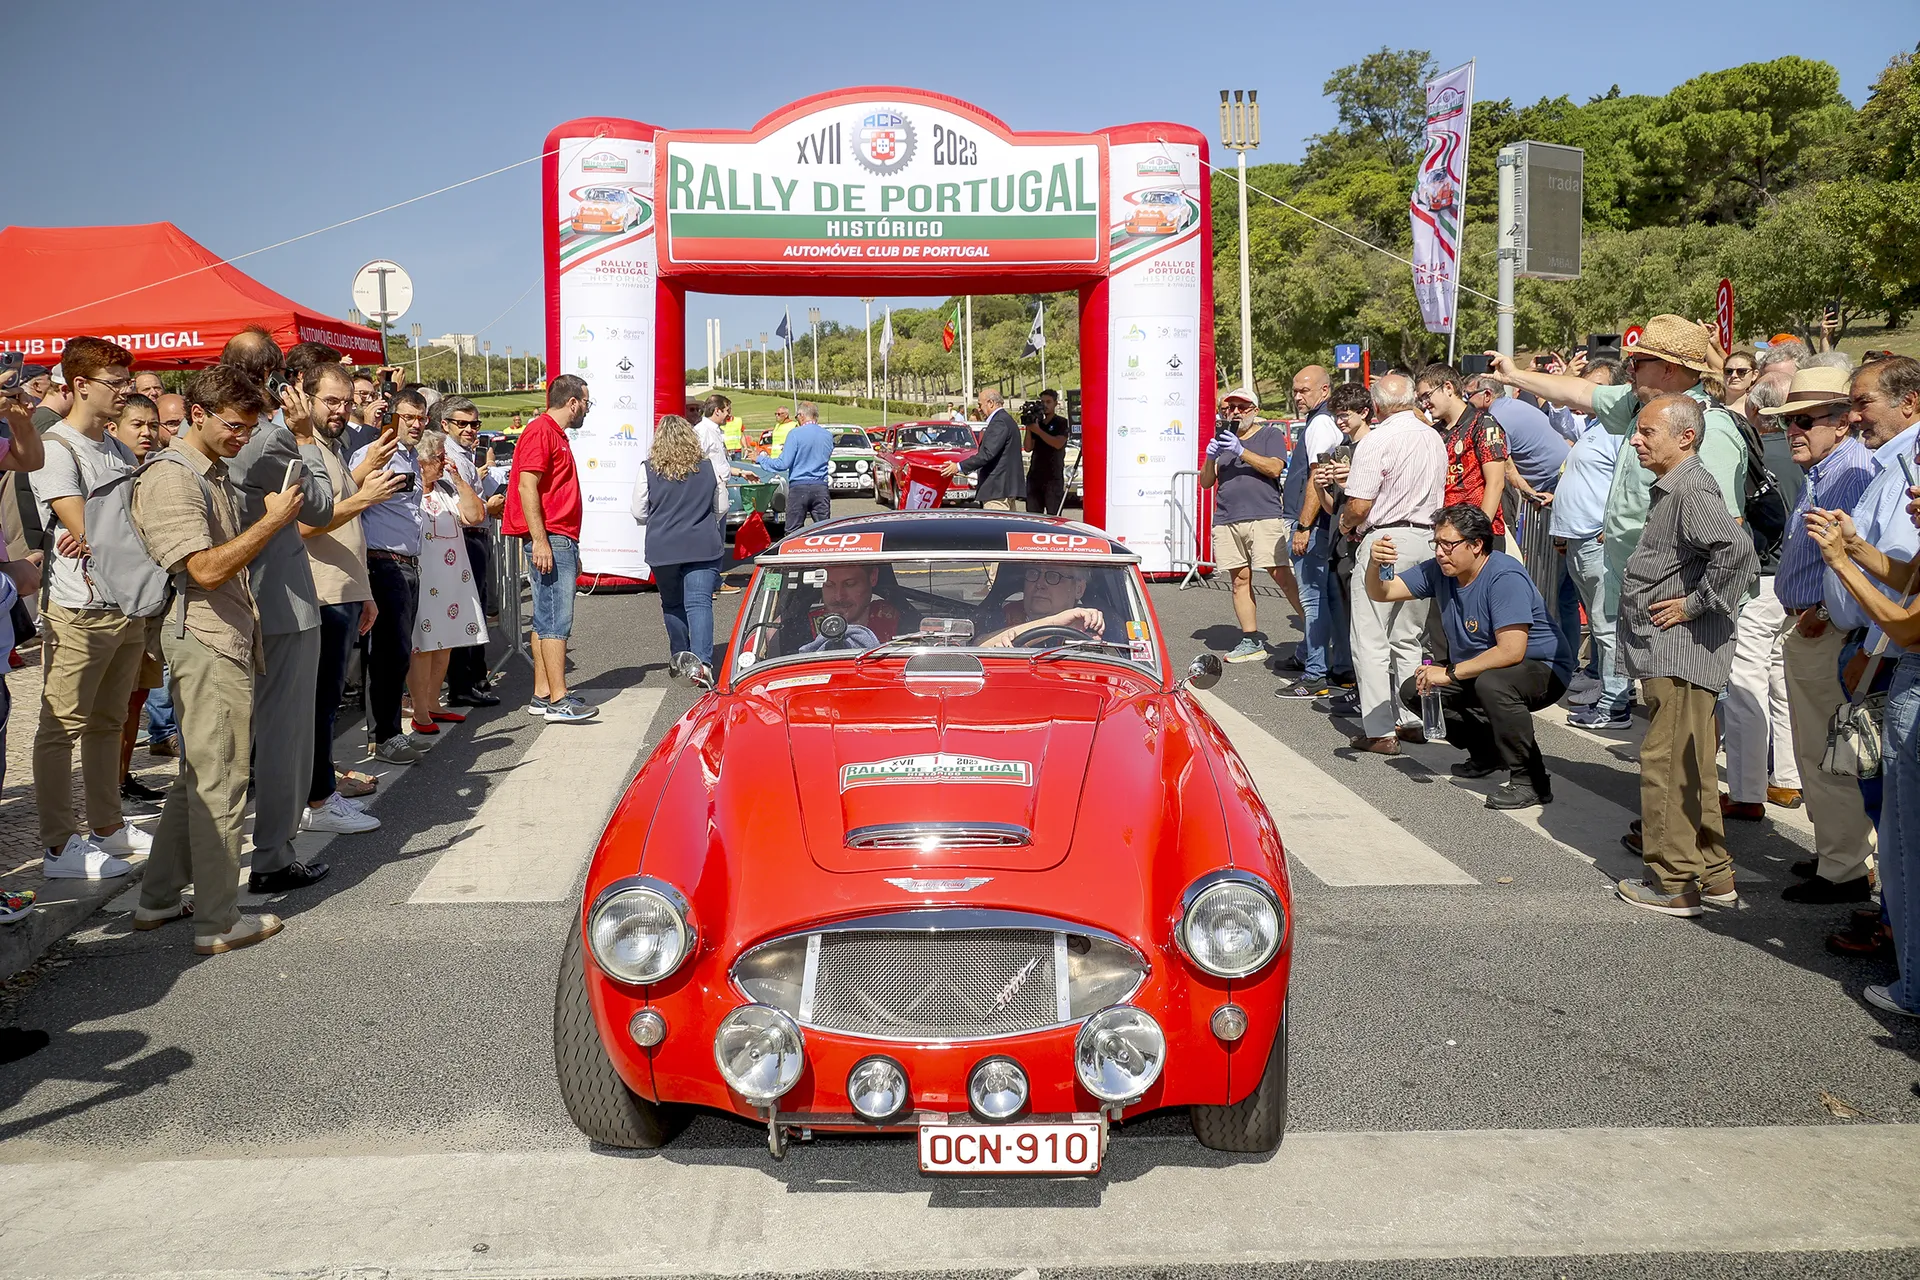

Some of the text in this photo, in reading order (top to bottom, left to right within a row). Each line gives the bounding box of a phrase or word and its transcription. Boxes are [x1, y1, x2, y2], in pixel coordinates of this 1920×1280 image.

[863, 113, 903, 128] ACP
[796, 121, 842, 165] XVII
[933, 123, 978, 166] 2023
[669, 154, 1097, 213] RALLY DE PORTUGAL
[826, 217, 944, 238] HISTÓRICO
[783, 243, 990, 257] AUTOMÓVEL CLUB DE PORTUGAL
[601, 260, 649, 269] RALLY DE
[1148, 267, 1196, 275] PORTUGAL
[1154, 260, 1183, 268] RALLY
[595, 267, 649, 276] PORTUGAL
[51, 337, 70, 354] D
[94, 330, 205, 351] ORTUGAL
[333, 332, 348, 348] CLUB
[355, 336, 382, 353] PORTUGAL
[608, 440, 639, 448] SINTRA
[804, 534, 861, 548] acp
[1031, 533, 1088, 548] acp
[933, 756, 939, 765] 1
[956, 757, 979, 766] 2023
[846, 766, 899, 776] RALLY
[933, 763, 1024, 773] PORTUGAL
